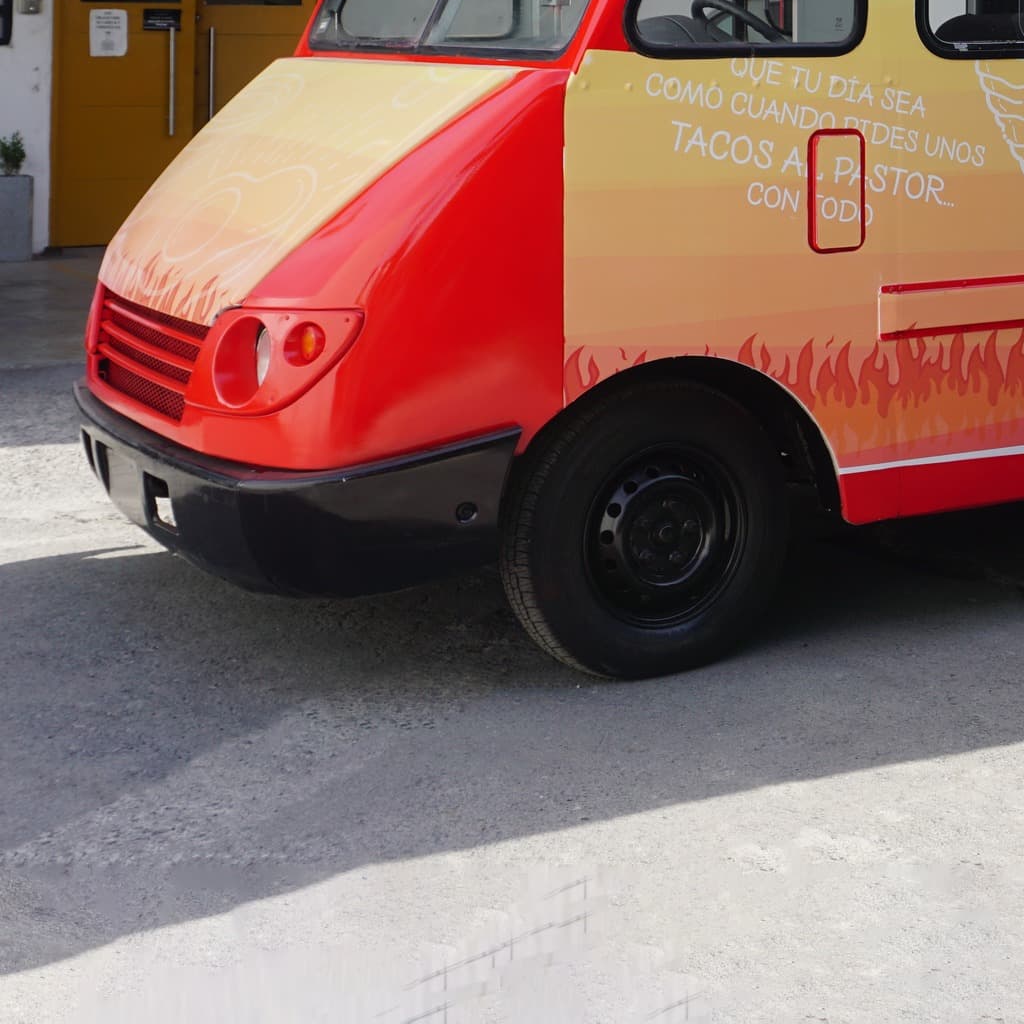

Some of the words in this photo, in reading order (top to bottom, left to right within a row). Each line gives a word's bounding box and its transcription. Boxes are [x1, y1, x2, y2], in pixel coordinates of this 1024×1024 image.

[732, 57, 783, 86] QUE
[791, 65, 821, 93] TU
[828, 74, 874, 106] DÍA
[880, 88, 926, 118] SEA
[646, 73, 723, 109] COMO
[731, 92, 836, 130] CUANDO
[925, 134, 985, 167] UNOS
[671, 120, 773, 169] TACOS
[747, 182, 800, 212] CON
